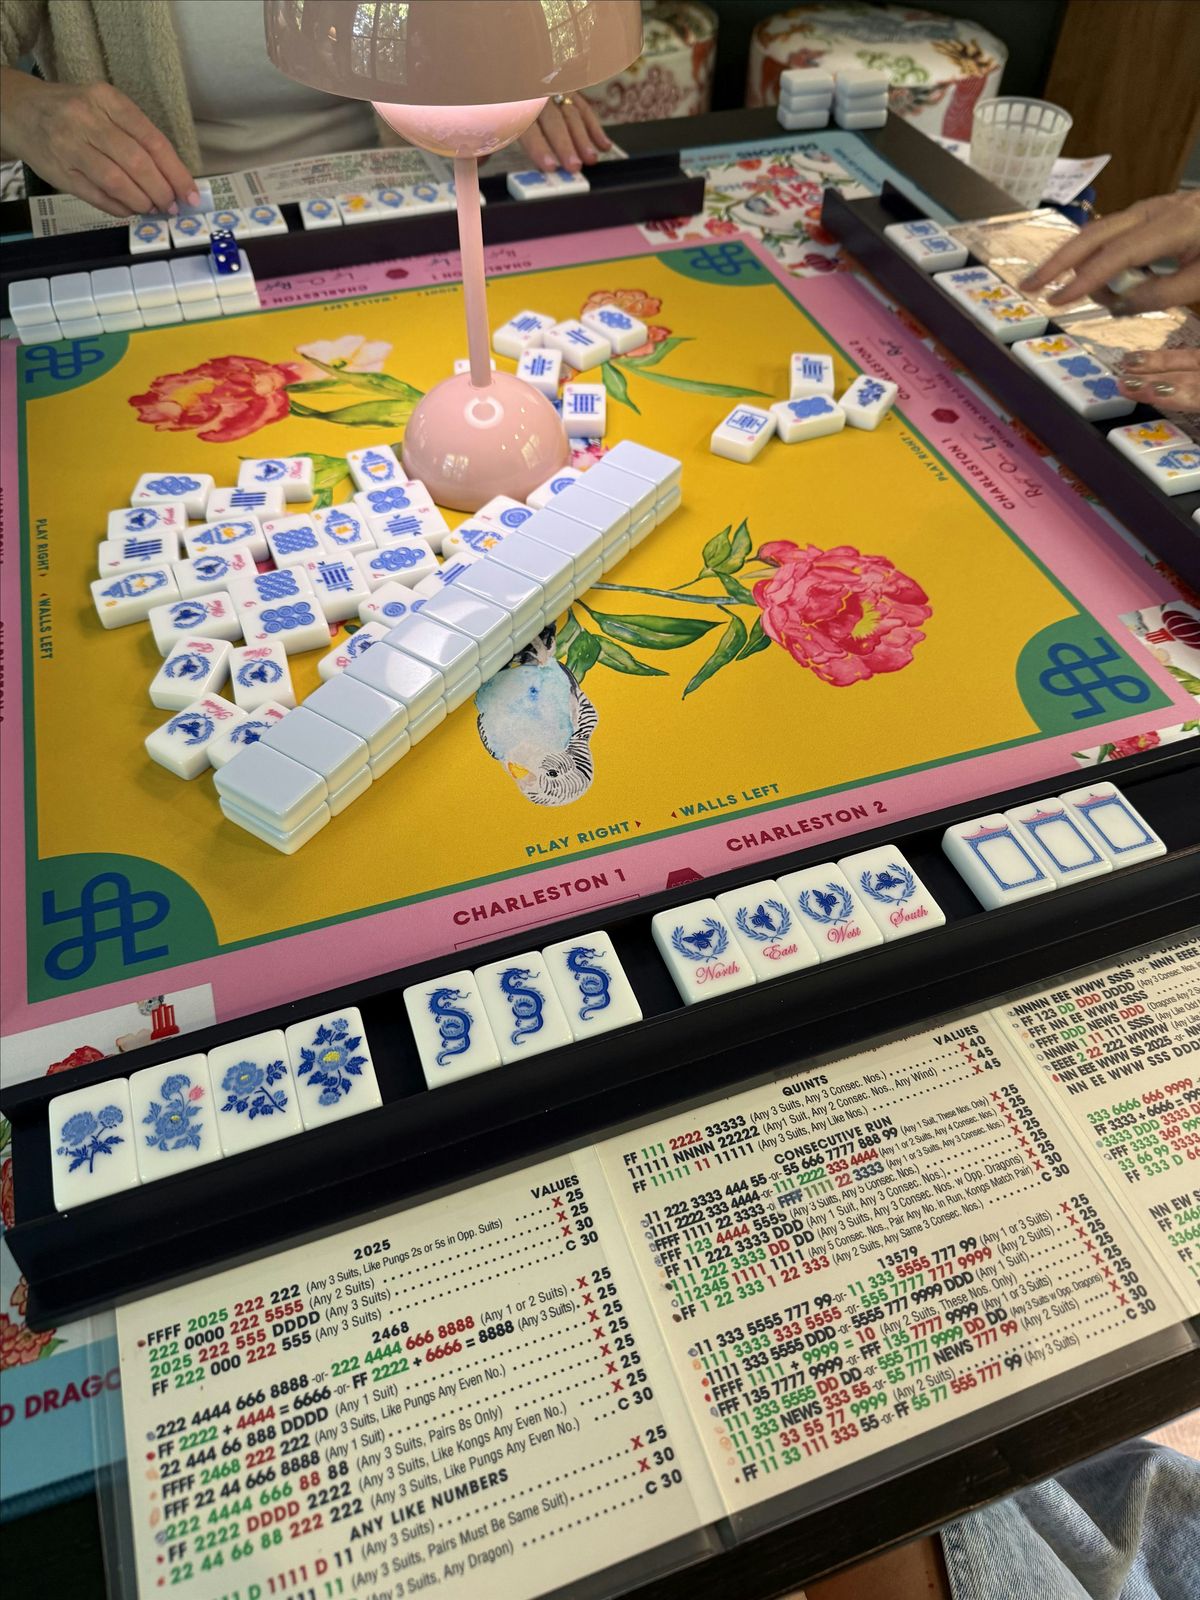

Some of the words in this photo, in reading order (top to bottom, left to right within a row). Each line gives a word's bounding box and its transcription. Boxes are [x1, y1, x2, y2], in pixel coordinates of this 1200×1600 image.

[856, 348, 910, 401] CHRLESTON
[949, 444, 1016, 511] CHARLESTON
[36, 518, 48, 541] PLAY
[37, 542, 49, 571] RIGHT
[39, 598, 53, 636] WALLS
[40, 636, 54, 660] LEFT
[679, 795, 738, 818] WALLS
[742, 783, 781, 802] LEFT
[525, 837, 570, 858] PLAY
[578, 821, 631, 845] RIGHT
[727, 805, 867, 853] CHARLESTON
[868, 800, 888, 814] 2
[453, 873, 608, 926] CHARLESTON
[615, 868, 627, 882] 1
[827, 920, 862, 944] West
[890, 905, 928, 928] South
[763, 943, 798, 960] East
[695, 962, 740, 985] North
[1013, 999, 1049, 1017] NNNN
[1050, 989, 1073, 1004] EEE
[1070, 977, 1106, 997] WWW
[1106, 968, 1135, 985] SSSS
[1019, 1014, 1034, 1028] FF
[1033, 1007, 1058, 1022] 123
[1056, 1002, 1076, 1015] DD
[1074, 993, 1102, 1009] DDD
[1100, 981, 1136, 1000] DDDD
[932, 1024, 980, 1046] VALUES
[622, 1151, 638, 1167] FF
[640, 1142, 666, 1160] 111
[668, 1129, 704, 1151] 2222
[704, 1114, 747, 1138] 33333
[749, 1109, 770, 1125] (Any
[778, 1099, 805, 1113] Suits,
[804, 1093, 821, 1105] Any
[828, 1080, 864, 1096] Consec.
[862, 1069, 888, 1085] Nos.)
[956, 1041, 970, 1052] X
[969, 1035, 987, 1048] 40
[781, 1074, 829, 1097] QUINTS
[1086, 1108, 1111, 1125] 333
[1111, 1097, 1142, 1116] 6666
[1141, 1088, 1165, 1105] 666
[1163, 1077, 1194, 1096] 9999
[627, 1156, 670, 1180] 11111
[672, 1140, 716, 1165] NNNN
[717, 1125, 761, 1149] 22222
[788, 1111, 811, 1125] Suit,
[810, 1105, 828, 1118] Any
[835, 1092, 871, 1108] Consec.
[894, 1076, 911, 1089] Any
[910, 1066, 939, 1082] Wind)
[963, 1052, 977, 1064] X
[977, 1046, 994, 1059] 45
[773, 1125, 864, 1165] CONSECUTIVE
[864, 1115, 893, 1133] RUN
[530, 1174, 580, 1199] VALUES
[147, 1322, 182, 1347] FFFF
[187, 1307, 229, 1333] 2025
[233, 1295, 265, 1318] 222
[269, 1283, 301, 1305] 222
[306, 1279, 327, 1295] (Any
[336, 1268, 362, 1283] Suits,
[362, 1261, 381, 1274] Like
[382, 1251, 411, 1267] Pungs
[410, 1247, 423, 1258] 2s
[423, 1243, 433, 1254] or
[434, 1238, 447, 1250] 5s
[446, 1235, 456, 1245] in
[456, 1229, 478, 1242] Opp.
[477, 1217, 503, 1234] Suits)
[551, 1195, 564, 1209] X
[565, 1187, 584, 1204] 25
[353, 1238, 391, 1261] 2025
[876, 1245, 919, 1270] 13579
[148, 1341, 180, 1363] 222
[184, 1325, 225, 1351] 0000
[229, 1314, 260, 1336] 222
[264, 1298, 304, 1323] 5555
[308, 1292, 333, 1311] (Any
[344, 1276, 375, 1296] Suits)
[556, 1210, 569, 1223] X
[570, 1201, 589, 1218] 25
[150, 1353, 193, 1380] 2025
[198, 1341, 230, 1364] 222
[235, 1328, 267, 1350] 555
[271, 1310, 321, 1338] DDDD
[325, 1303, 349, 1322] (Any
[360, 1287, 391, 1307] Suits)
[560, 1224, 573, 1238] X
[575, 1216, 594, 1232] 30
[371, 1320, 410, 1344] 2468
[736, 1437, 776, 1465] 1111
[779, 1427, 801, 1448] 33
[803, 1417, 825, 1438] 55
[825, 1408, 845, 1429] 77
[849, 1392, 888, 1418] 9999
[924, 1366, 959, 1390] Suits)
[1115, 1292, 1131, 1307] X
[1128, 1284, 1148, 1301] 30
[349, 1515, 383, 1542] ANY
[390, 1499, 426, 1526] LIKE
[431, 1468, 509, 1510] NUMBERS
